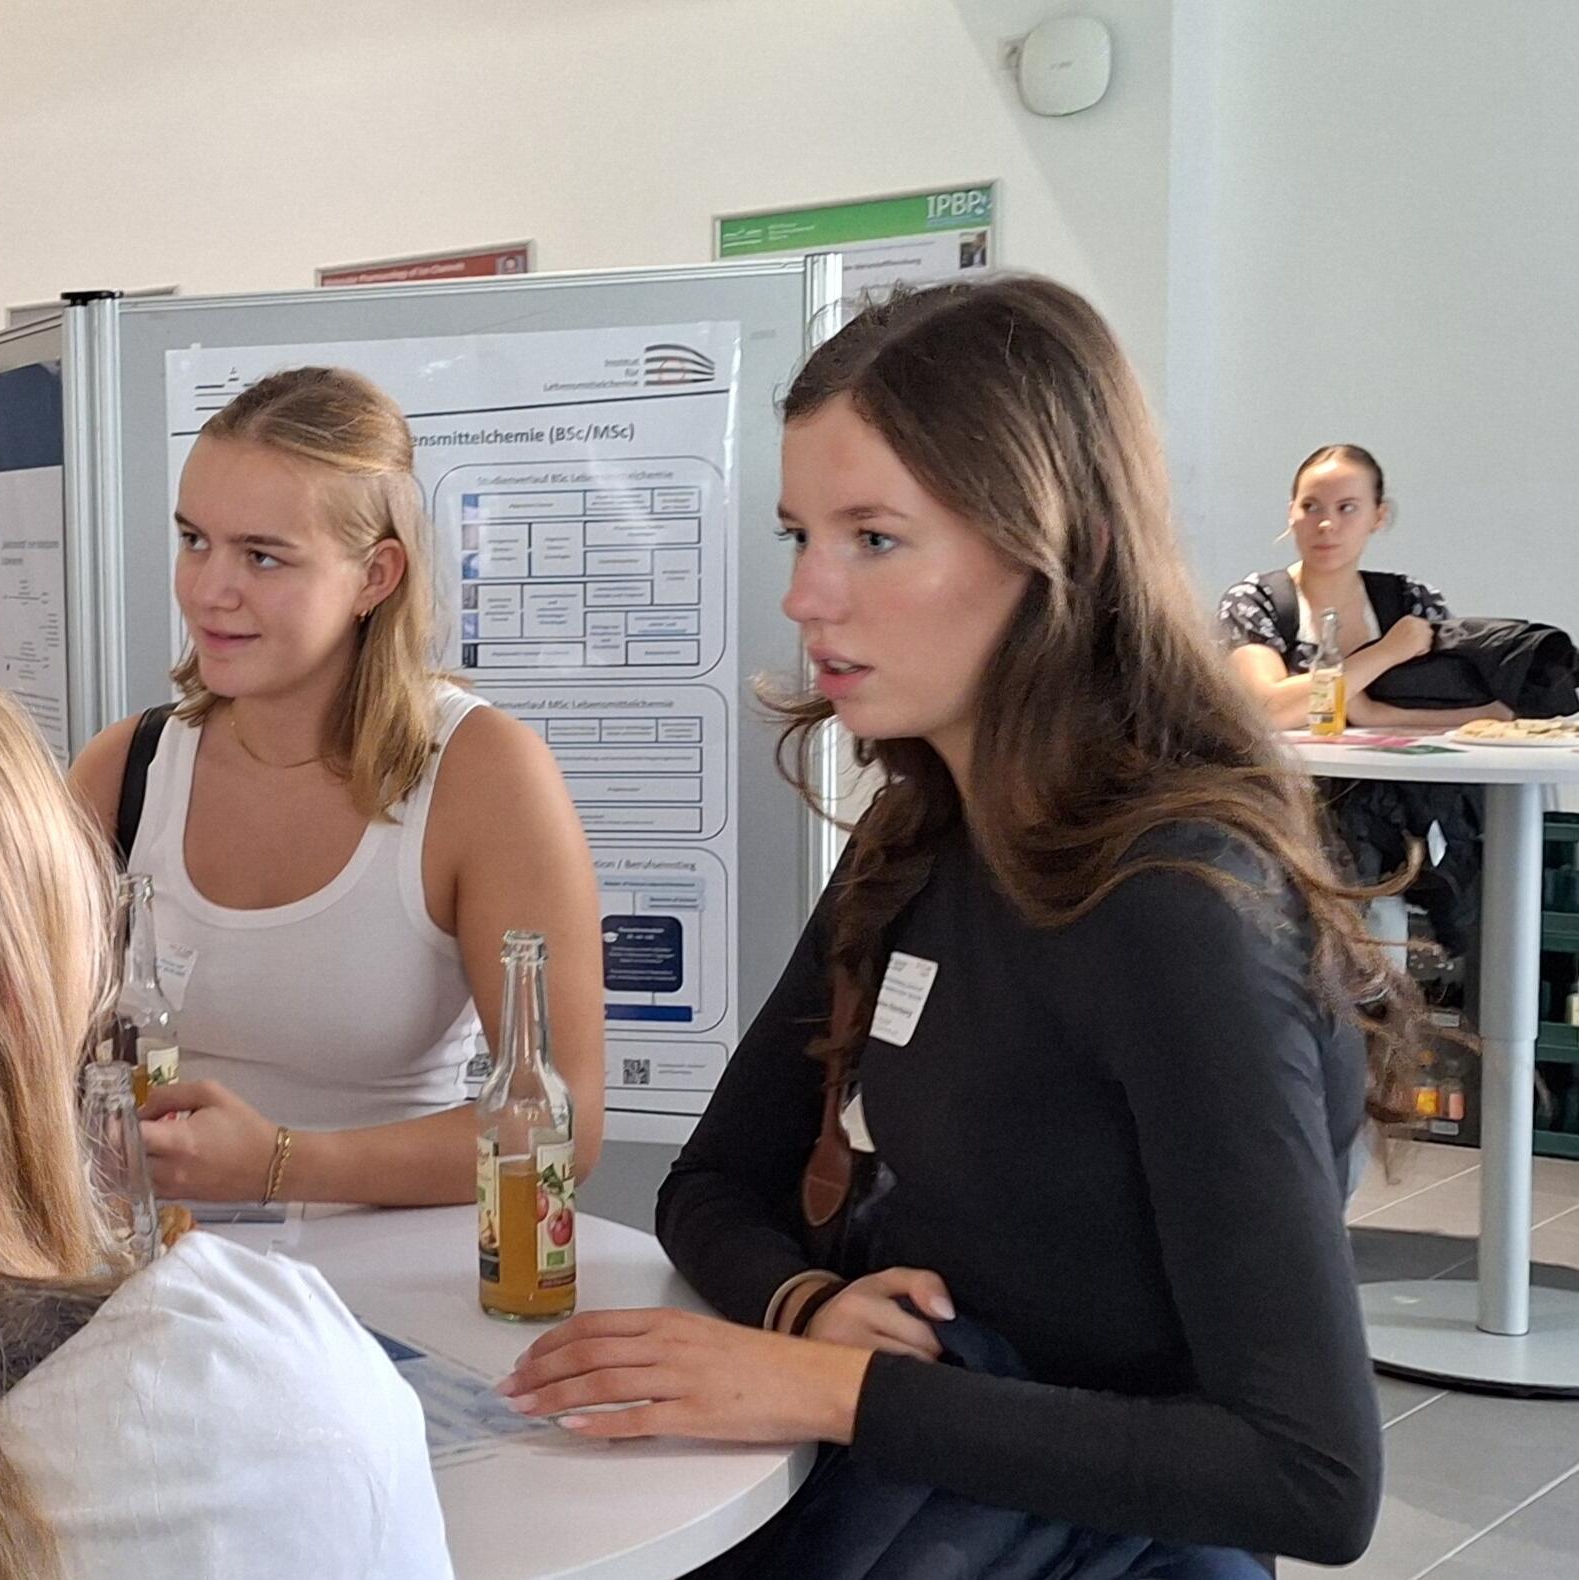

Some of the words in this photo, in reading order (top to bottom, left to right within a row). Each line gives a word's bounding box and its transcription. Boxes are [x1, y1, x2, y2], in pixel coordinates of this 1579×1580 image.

[926, 190, 982, 219] IPBP
[411, 428, 545, 448] ensmittelchemie
[549, 422, 636, 444] (BSc/MSc)
